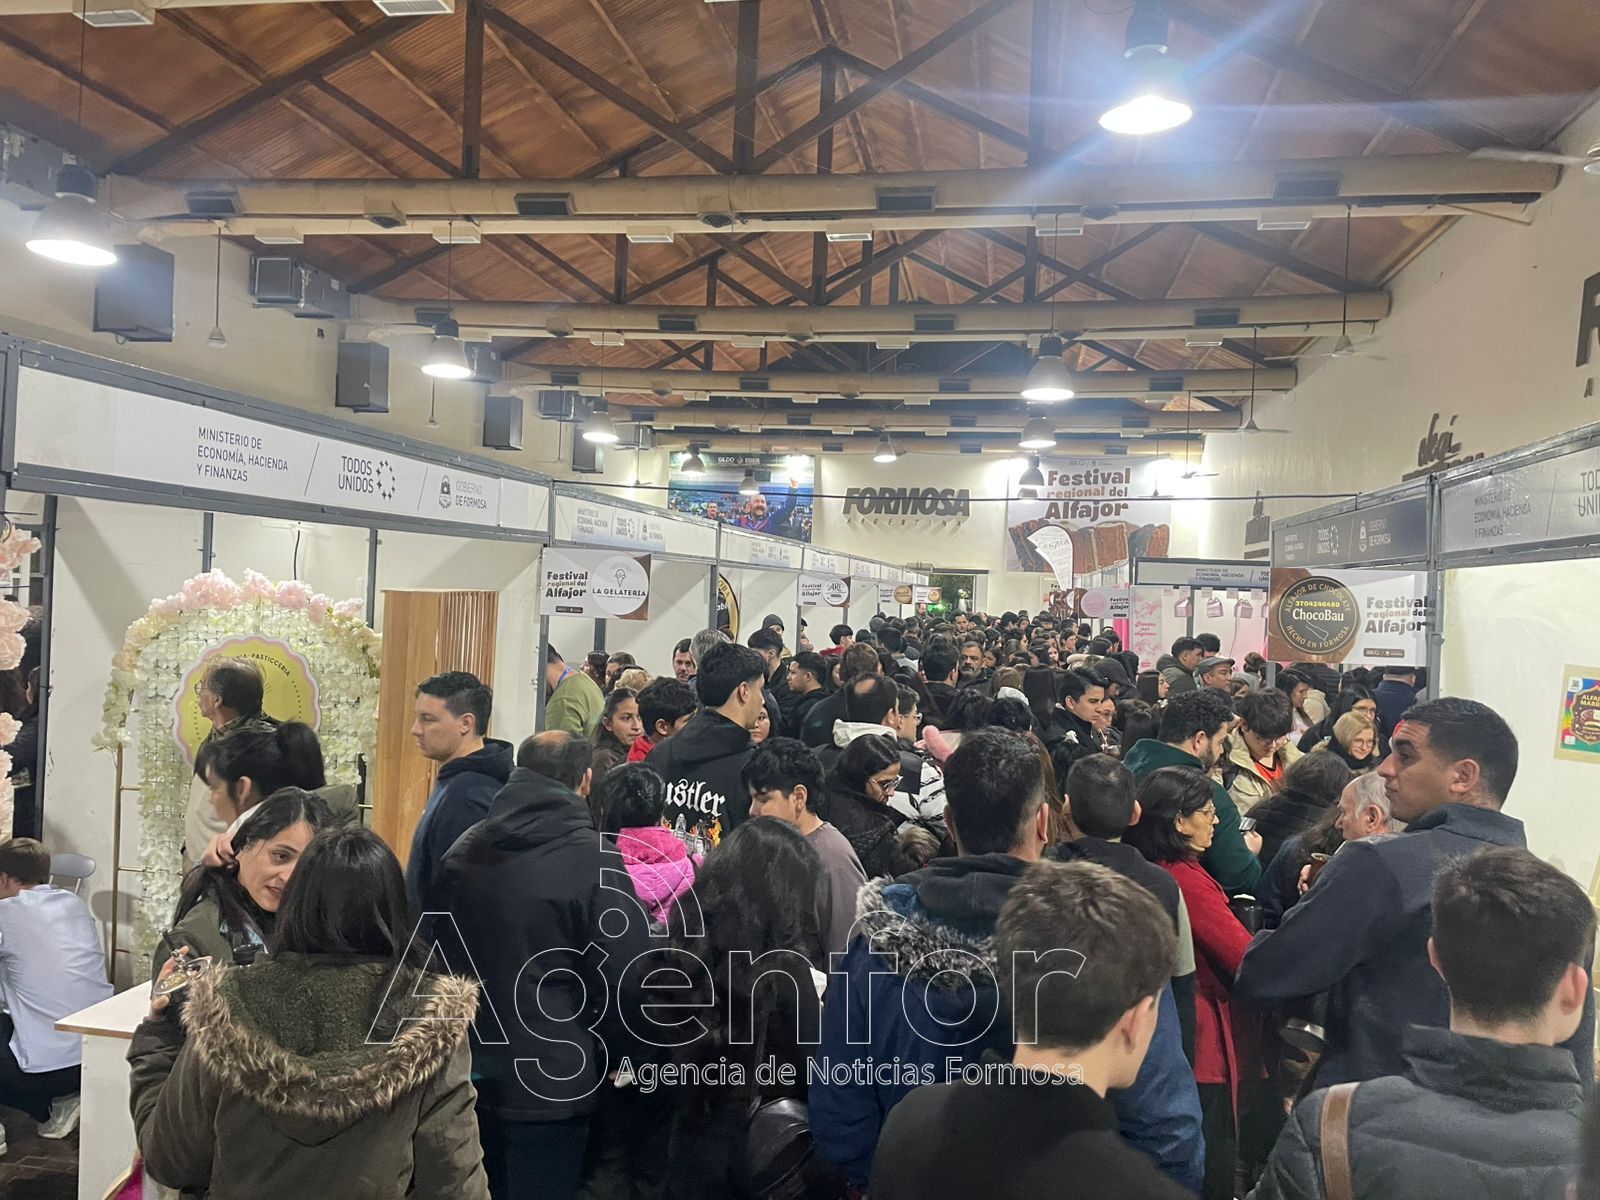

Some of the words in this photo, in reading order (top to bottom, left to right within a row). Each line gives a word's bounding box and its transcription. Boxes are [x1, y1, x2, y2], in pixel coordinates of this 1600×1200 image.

[198, 427, 249, 447] MINISTERIO
[251, 438, 262, 449] DE
[197, 445, 246, 466] ECONOMÍA,
[249, 454, 288, 471] HACIENDA
[341, 456, 372, 476] TODOS
[196, 463, 203, 475] Y
[205, 465, 248, 482] FINANZAS
[1047, 467, 1131, 486] Festival
[1581, 469, 1600, 493] TOD
[338, 474, 374, 493] UNIDOS
[455, 480, 482, 495] GOBIERNO
[1046, 486, 1105, 499] regional
[1109, 486, 1128, 498] del
[455, 495, 462, 506] DE
[463, 496, 487, 509] FORMOSA
[843, 487, 969, 517] FORMOSA
[1044, 500, 1129, 522] Alfajor
[1578, 494, 1600, 517] UNI
[547, 571, 588, 580] Festival
[545, 587, 587, 599] Alfajor
[604, 588, 646, 596] GELATERIA
[1285, 586, 1306, 612] ALFAJOR
[1308, 583, 1317, 591] DE
[1319, 583, 1351, 612] CHOCOLATE
[1366, 596, 1428, 609] Festival
[1292, 608, 1344, 622] ChocoBau
[1366, 610, 1411, 619] regional
[1412, 609, 1427, 617] del
[1286, 624, 1306, 646] HECHO
[1319, 625, 1350, 648] FORMOSA
[1365, 618, 1429, 635] Alfajor
[252, 653, 290, 677] PASTICCERIA
